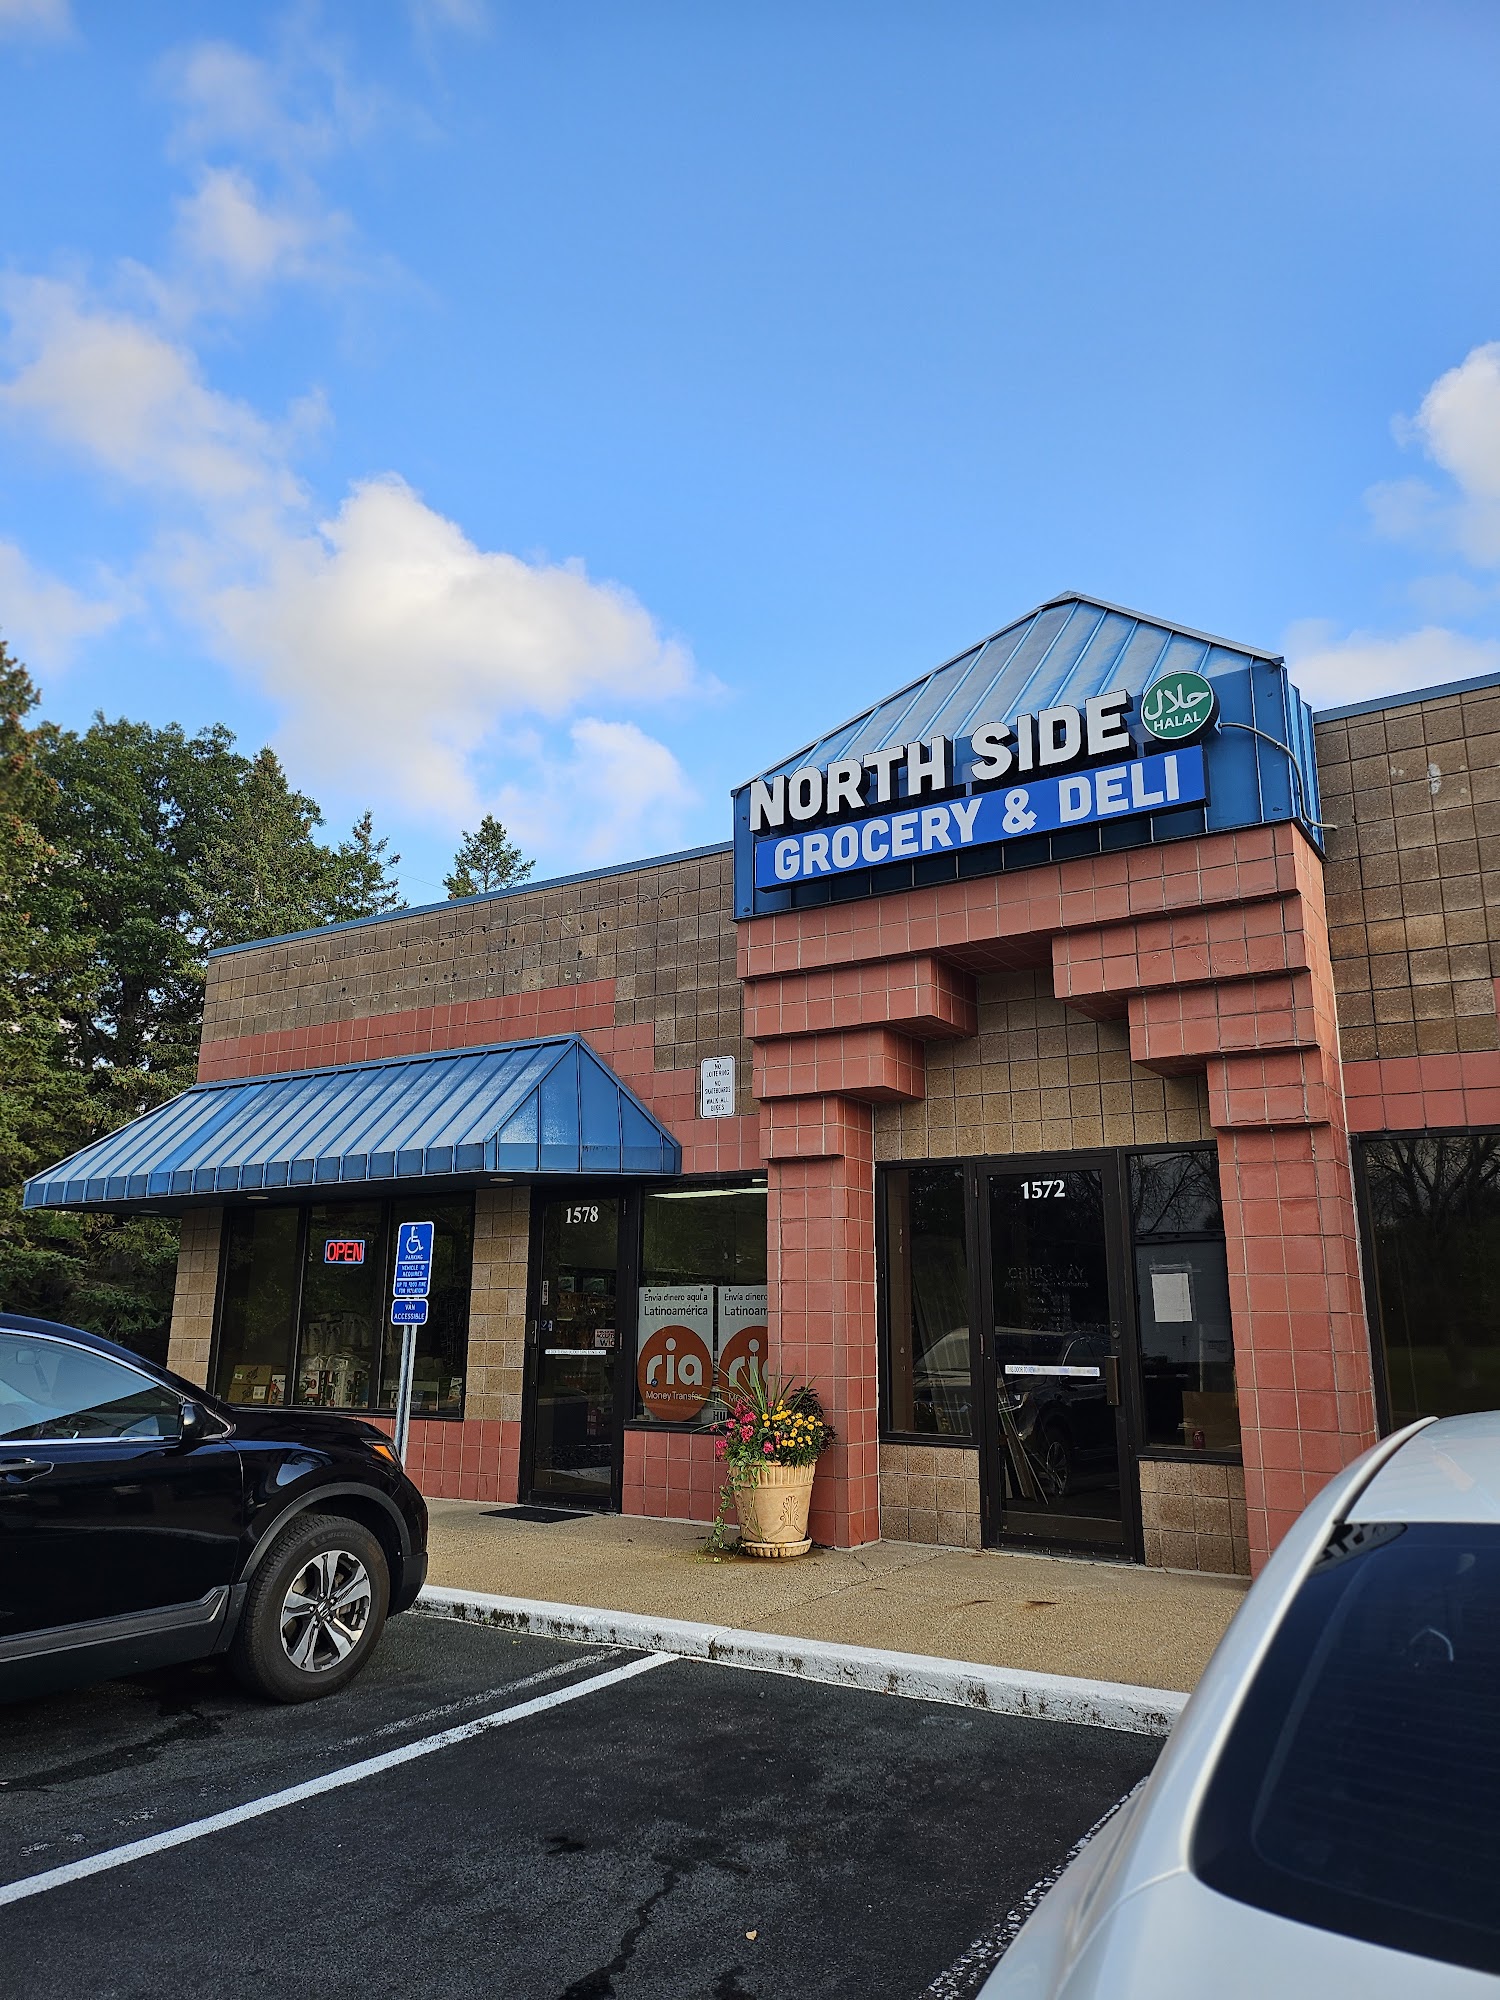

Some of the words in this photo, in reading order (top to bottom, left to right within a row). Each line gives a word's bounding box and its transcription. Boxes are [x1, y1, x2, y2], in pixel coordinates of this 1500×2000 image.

[1153, 711, 1201, 732] HALAL
[750, 736, 946, 832] NORTH
[970, 689, 1130, 781] SIDE
[774, 797, 983, 880] GROCERY
[1002, 788, 1038, 834] &
[1059, 754, 1180, 824] DELI
[1020, 1179, 1066, 1199] 1572
[565, 1206, 599, 1224] 1578
[327, 1242, 363, 1261] OPEN
[394, 1312, 425, 1320] ACCESSIBLE
[644, 1305, 708, 1316] Latinoamérica
[646, 1337, 703, 1386] ria
[645, 1390, 671, 1401] Money
